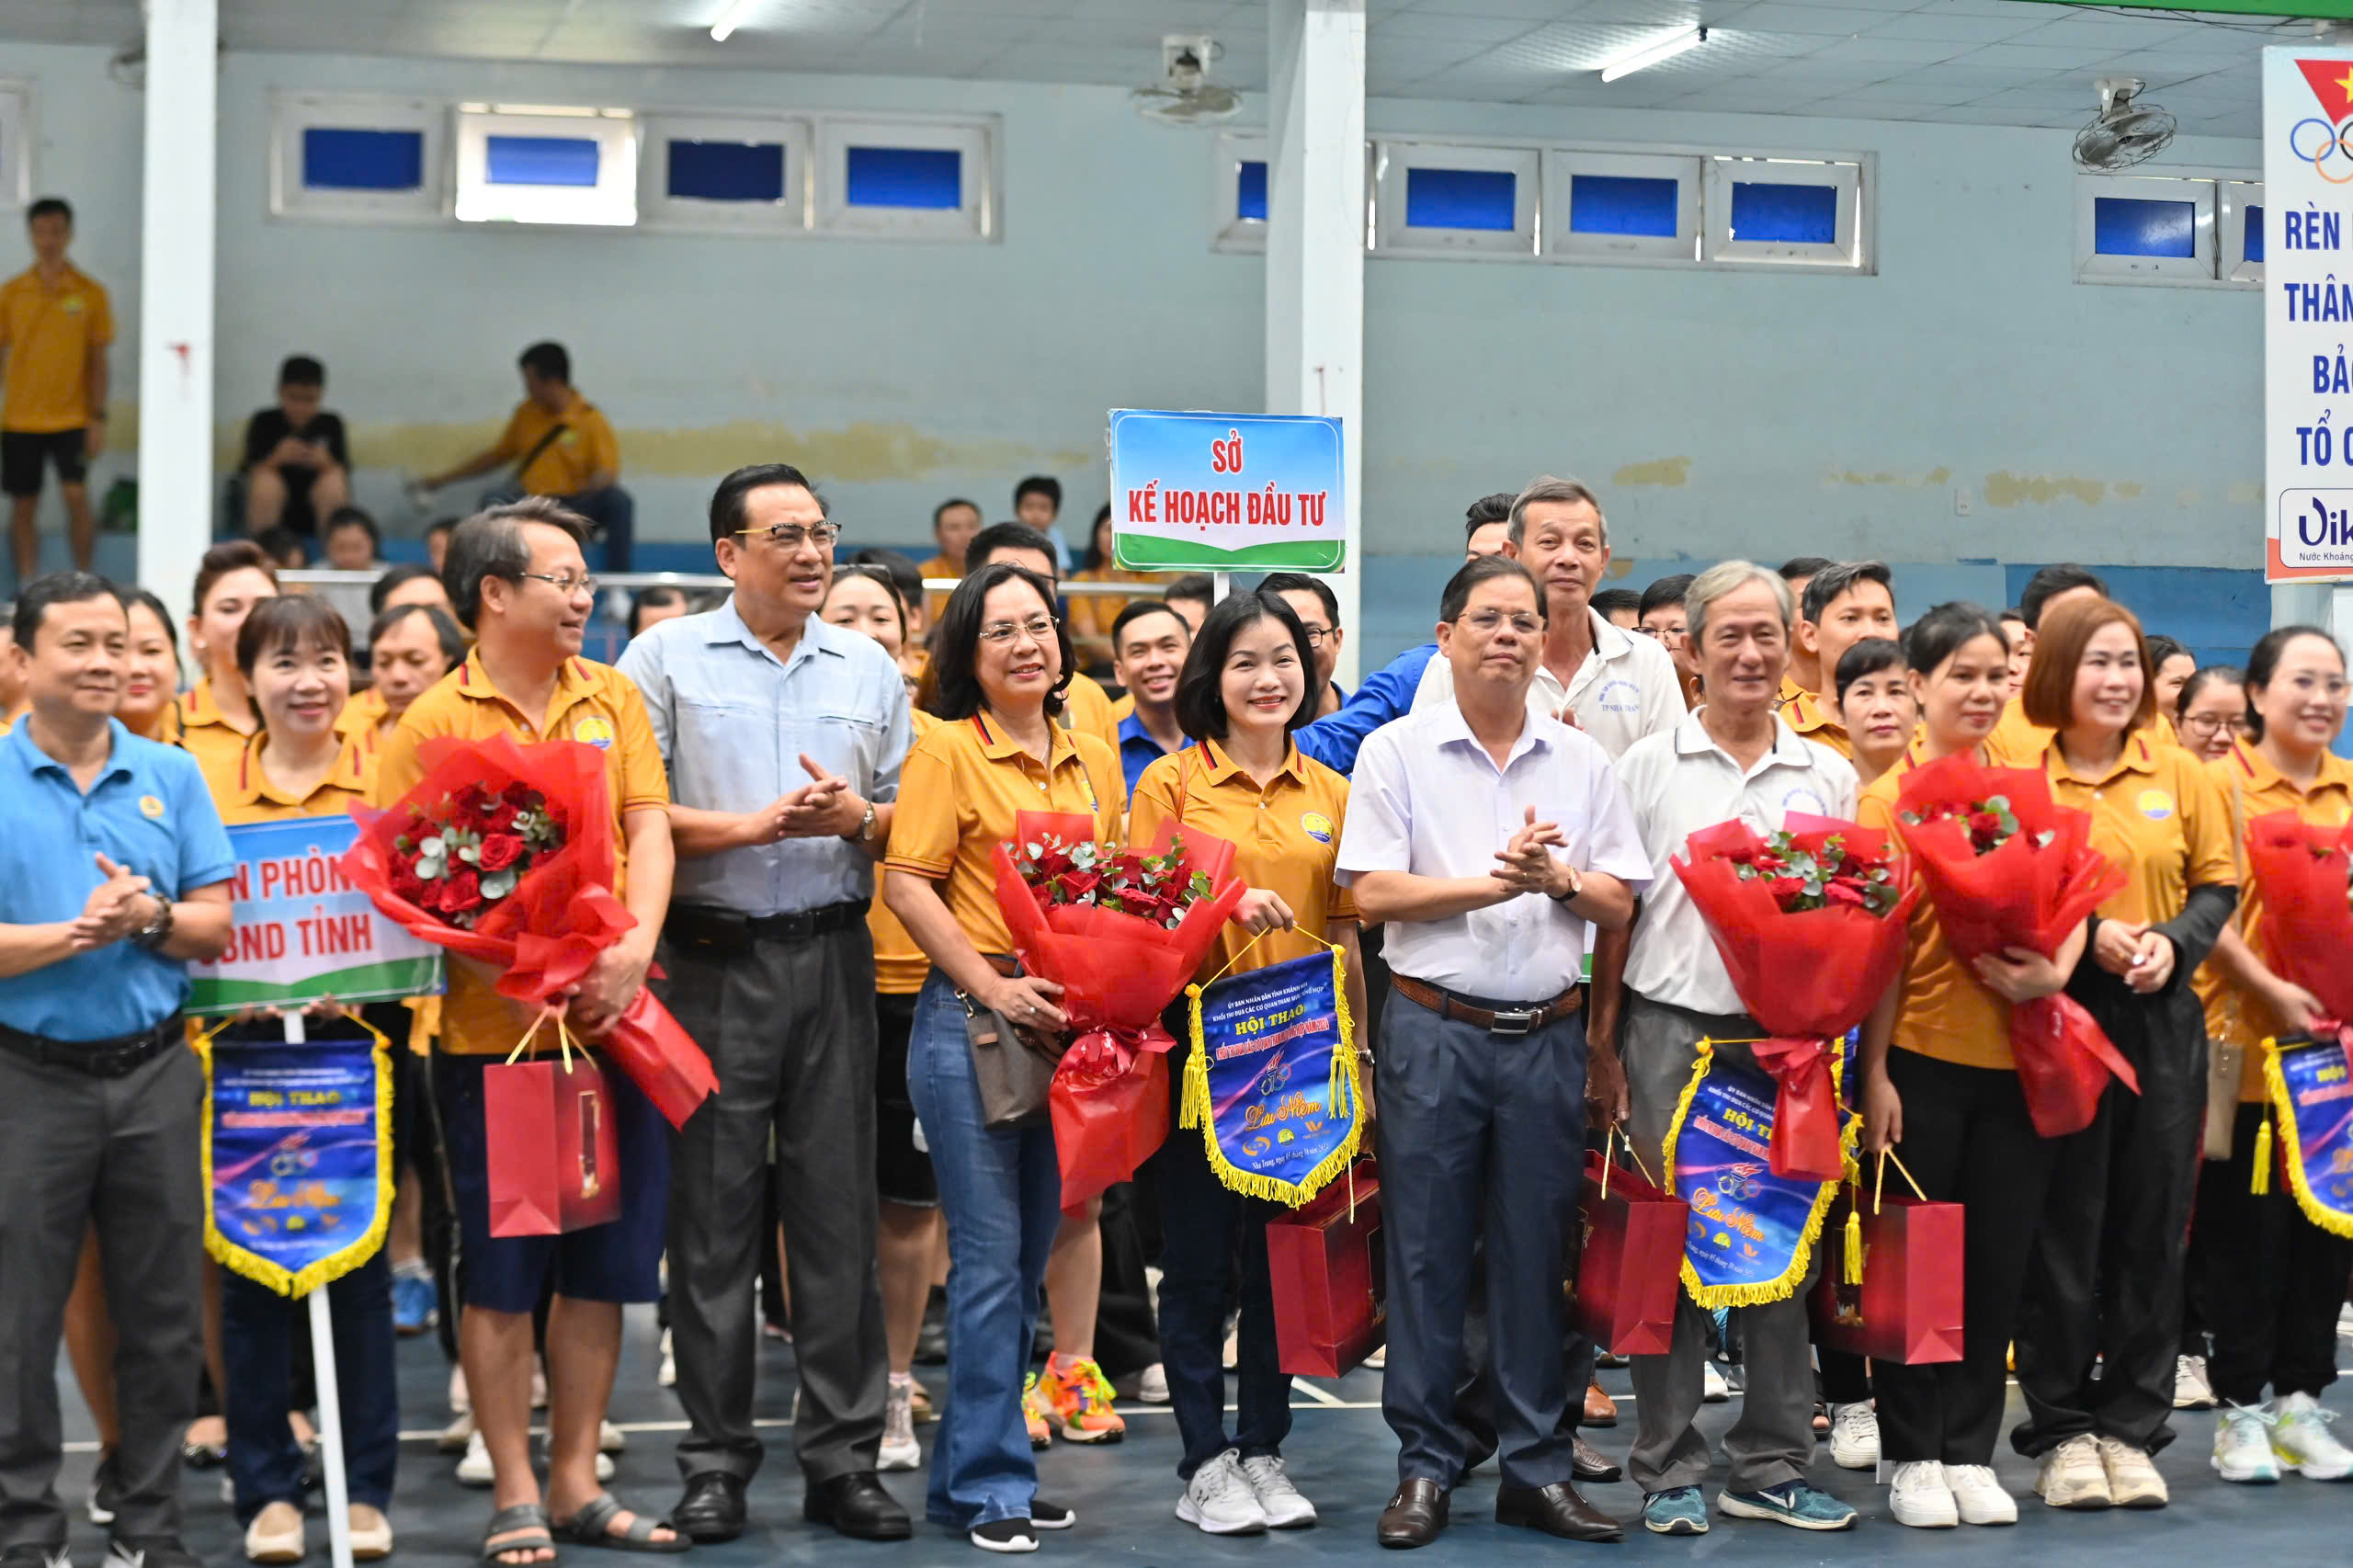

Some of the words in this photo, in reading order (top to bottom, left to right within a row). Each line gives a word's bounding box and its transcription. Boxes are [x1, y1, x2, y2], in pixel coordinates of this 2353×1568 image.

[2285, 200, 2340, 250] RÈN
[2283, 273, 2353, 323] THÂN
[2313, 343, 2353, 394] BẢ
[1212, 430, 1243, 473] SỞ
[2296, 408, 2332, 467] TỔ
[1129, 480, 1159, 523] KẾ
[1165, 490, 1240, 531] HOẠCH
[1246, 482, 1290, 526] ĐẦU
[1298, 491, 1327, 527] TƯ
[2300, 552, 2322, 562] Nước
[261, 846, 351, 901] PHÒN
[200, 922, 286, 967] BND
[296, 905, 373, 957] TỈNH
[1213, 1012, 1226, 1022] KHỐI
[1245, 1006, 1256, 1014] CÁC
[1264, 1001, 1278, 1011] QUAN
[1278, 996, 1291, 1006] THAM
[1235, 1017, 1265, 1035] HỘI
[1268, 1004, 1305, 1027] THAO
[1245, 995, 1261, 1005] NHÂN
[1261, 993, 1272, 1001] DÂN
[1245, 1103, 1276, 1131] Lưu
[1277, 1090, 1322, 1121] Niệm
[1722, 1108, 1755, 1131] HỘI
